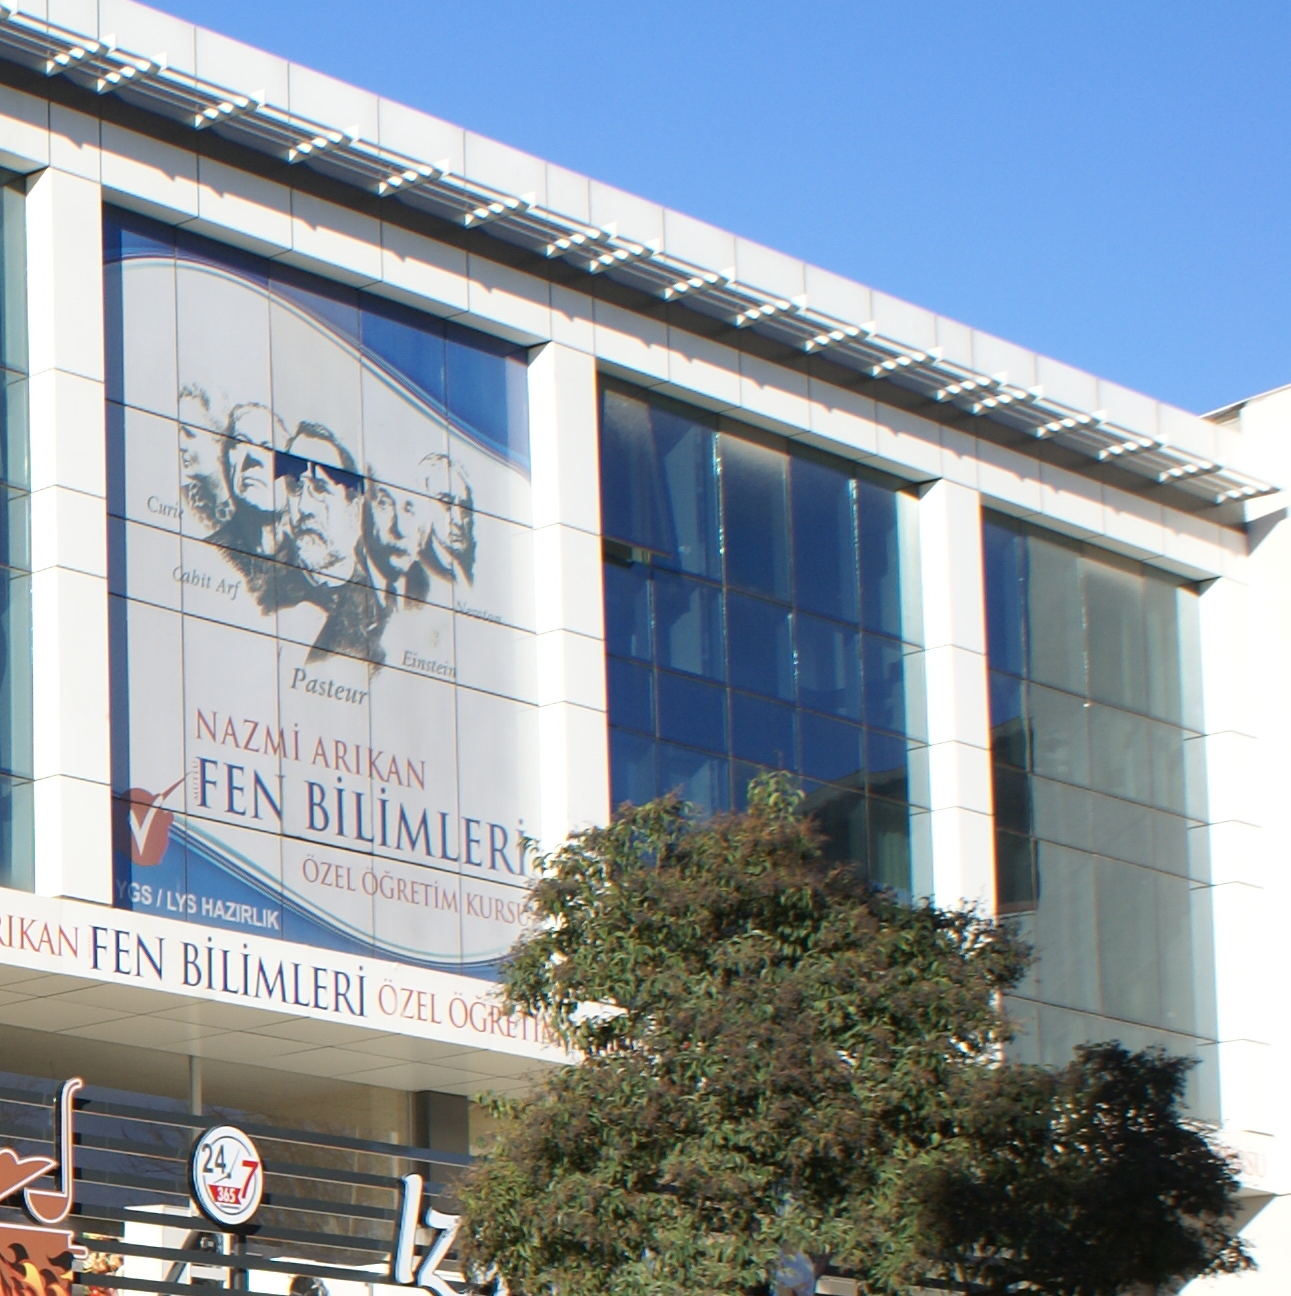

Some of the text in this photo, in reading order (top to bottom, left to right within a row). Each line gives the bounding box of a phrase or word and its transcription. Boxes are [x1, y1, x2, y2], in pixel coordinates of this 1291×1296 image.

[147, 495, 184, 520] Curie
[216, 578, 242, 600] Arf
[290, 666, 369, 705] Pasteur
[402, 649, 457, 678] Einstein
[196, 708, 426, 790] NAZMİ ARIKAN
[197, 756, 527, 876] FEN BİLİMLERİ
[115, 880, 152, 903] YGS
[167, 890, 197, 914] LYS
[202, 897, 279, 929] HAZIRLIK
[303, 853, 356, 892] ÖZEL
[362, 861, 458, 913] ÖĞRETİM
[88, 925, 164, 980] FEN
[182, 931, 369, 1019] BİLİMLERİ
[379, 978, 442, 1025] ÖZEL
[201, 1143, 258, 1199] 24 7
[216, 1186, 236, 1203] 365
